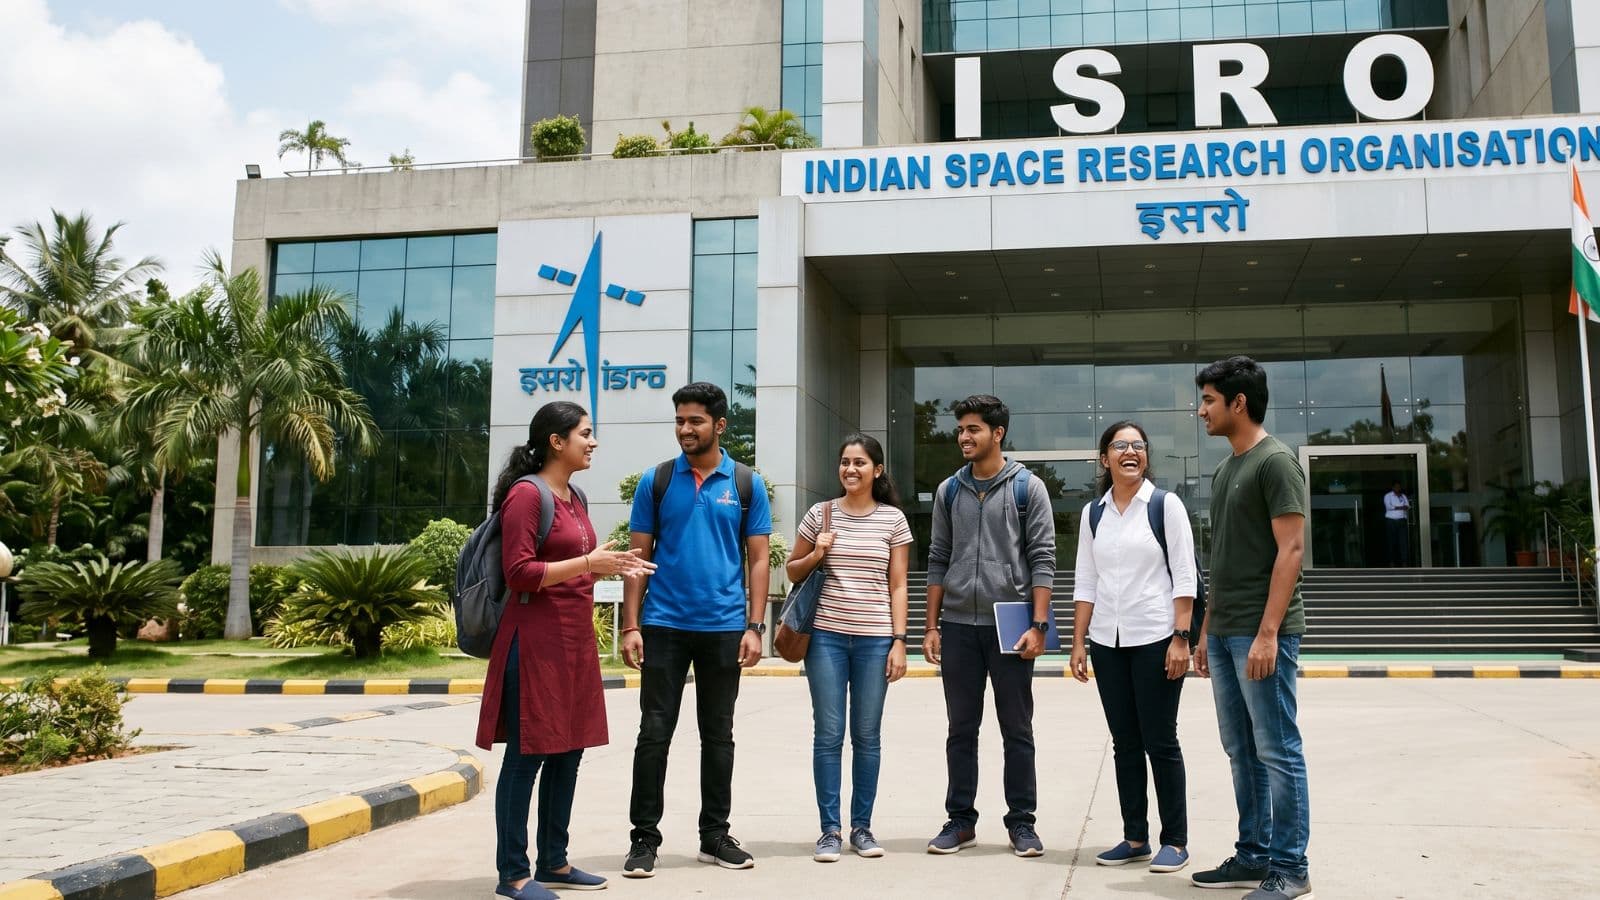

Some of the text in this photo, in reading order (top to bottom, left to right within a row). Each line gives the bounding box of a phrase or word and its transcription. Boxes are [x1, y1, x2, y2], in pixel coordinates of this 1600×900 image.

[955, 34, 1434, 138] ISRO
[805, 125, 1600, 194] INDIAN SPACE RESEARCH ORGANISATION
[1136, 187, 1250, 240] इसरो
[519, 359, 585, 395] इसरो
[601, 360, 667, 390] isro
